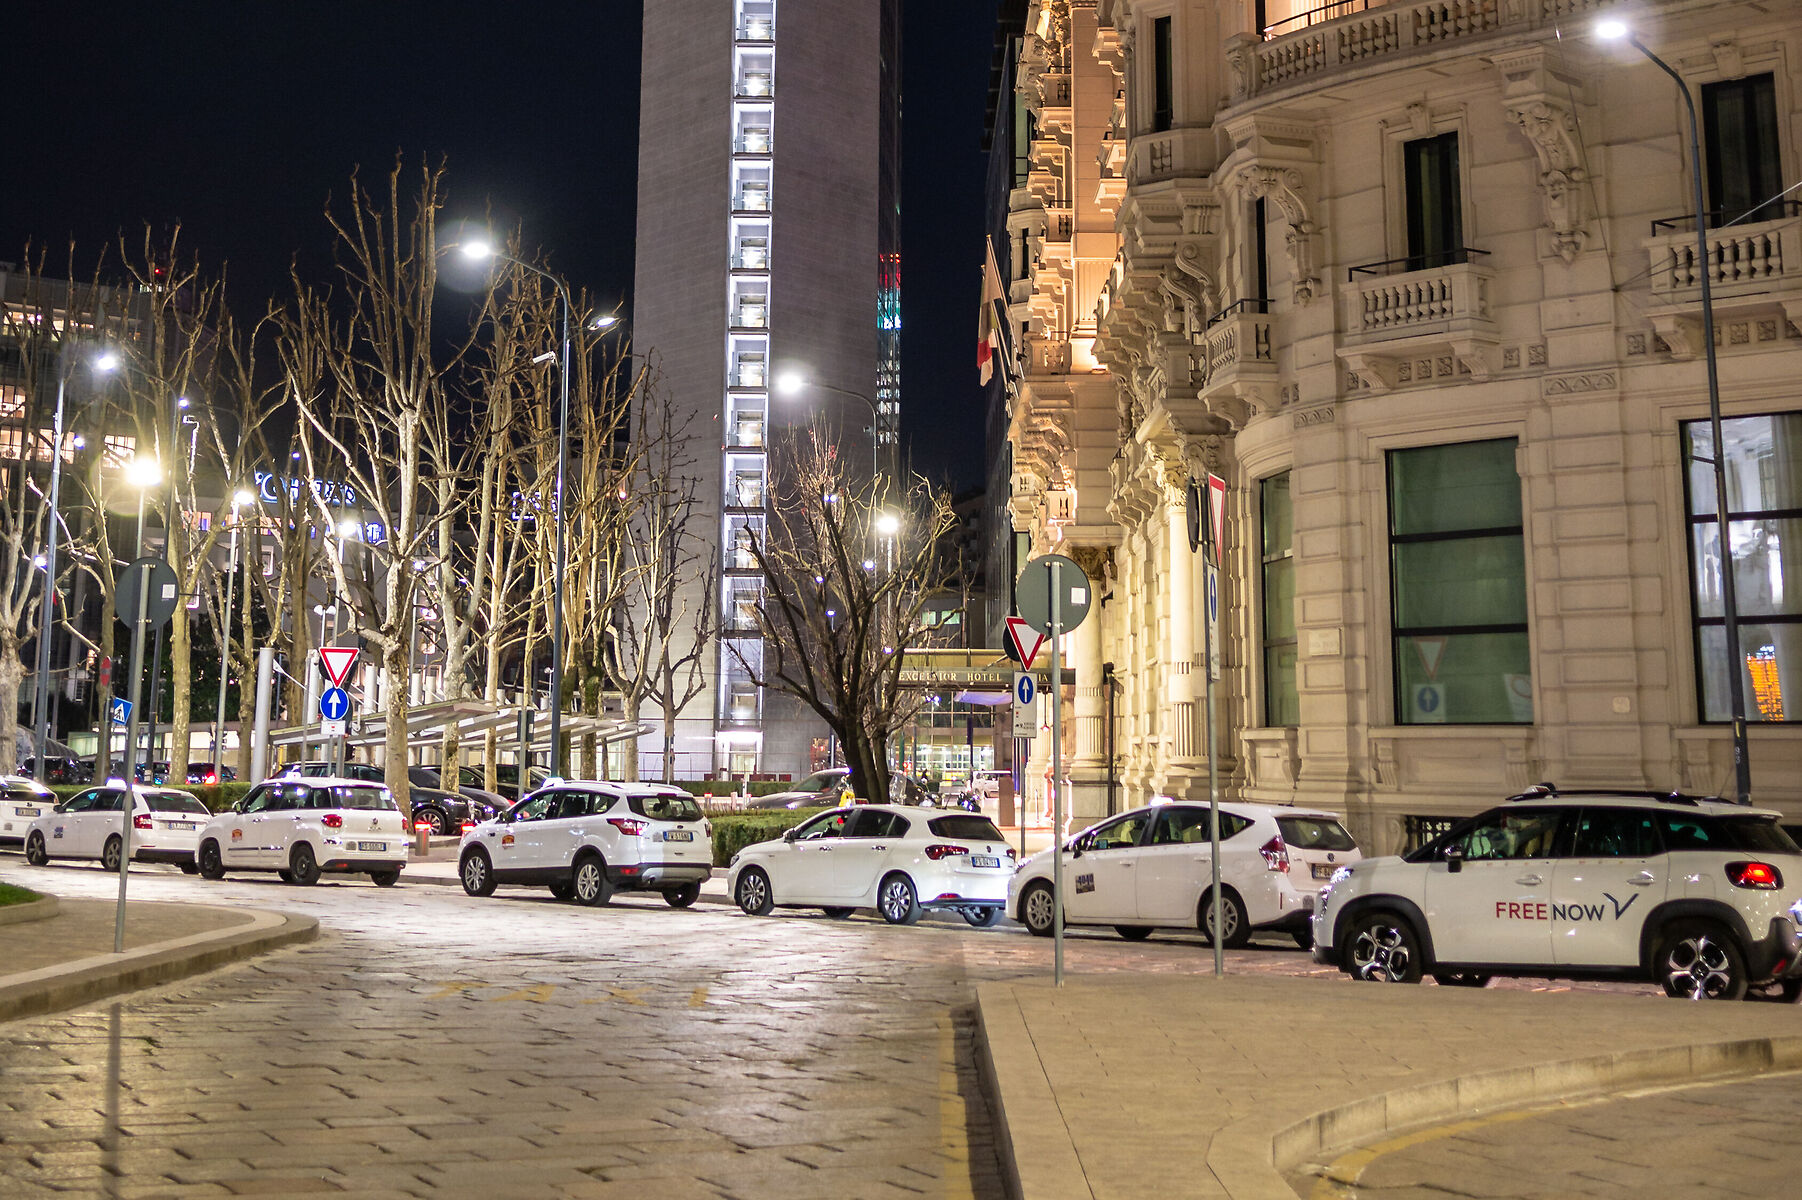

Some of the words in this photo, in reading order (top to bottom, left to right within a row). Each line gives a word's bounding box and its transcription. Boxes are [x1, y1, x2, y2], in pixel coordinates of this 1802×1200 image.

[967, 672, 1002, 681] HOTEL
[1496, 902, 1548, 920] FREE
[1552, 904, 1605, 921] NOW
